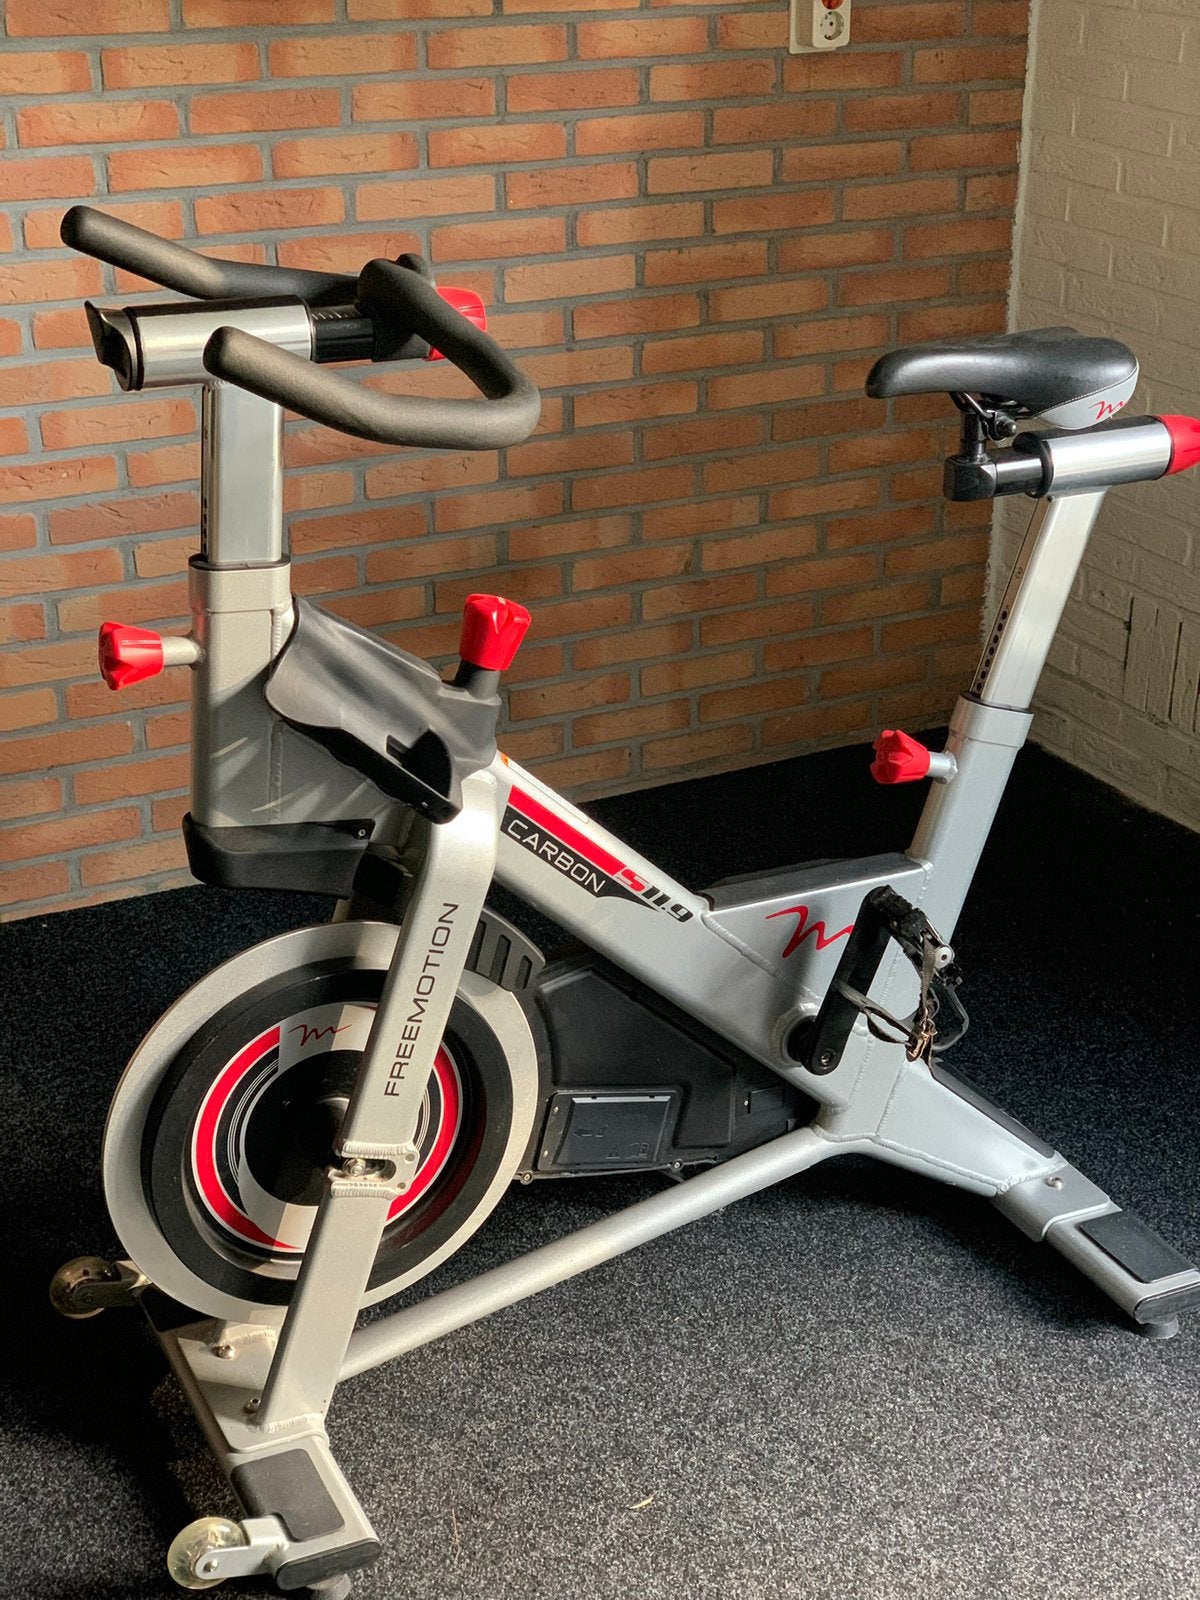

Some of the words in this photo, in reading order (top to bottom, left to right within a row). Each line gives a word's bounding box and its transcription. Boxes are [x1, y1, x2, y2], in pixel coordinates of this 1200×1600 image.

[507, 819, 606, 893] CARBON
[616, 868, 694, 923] S11.9
[384, 902, 459, 1096] FREEMOTION
